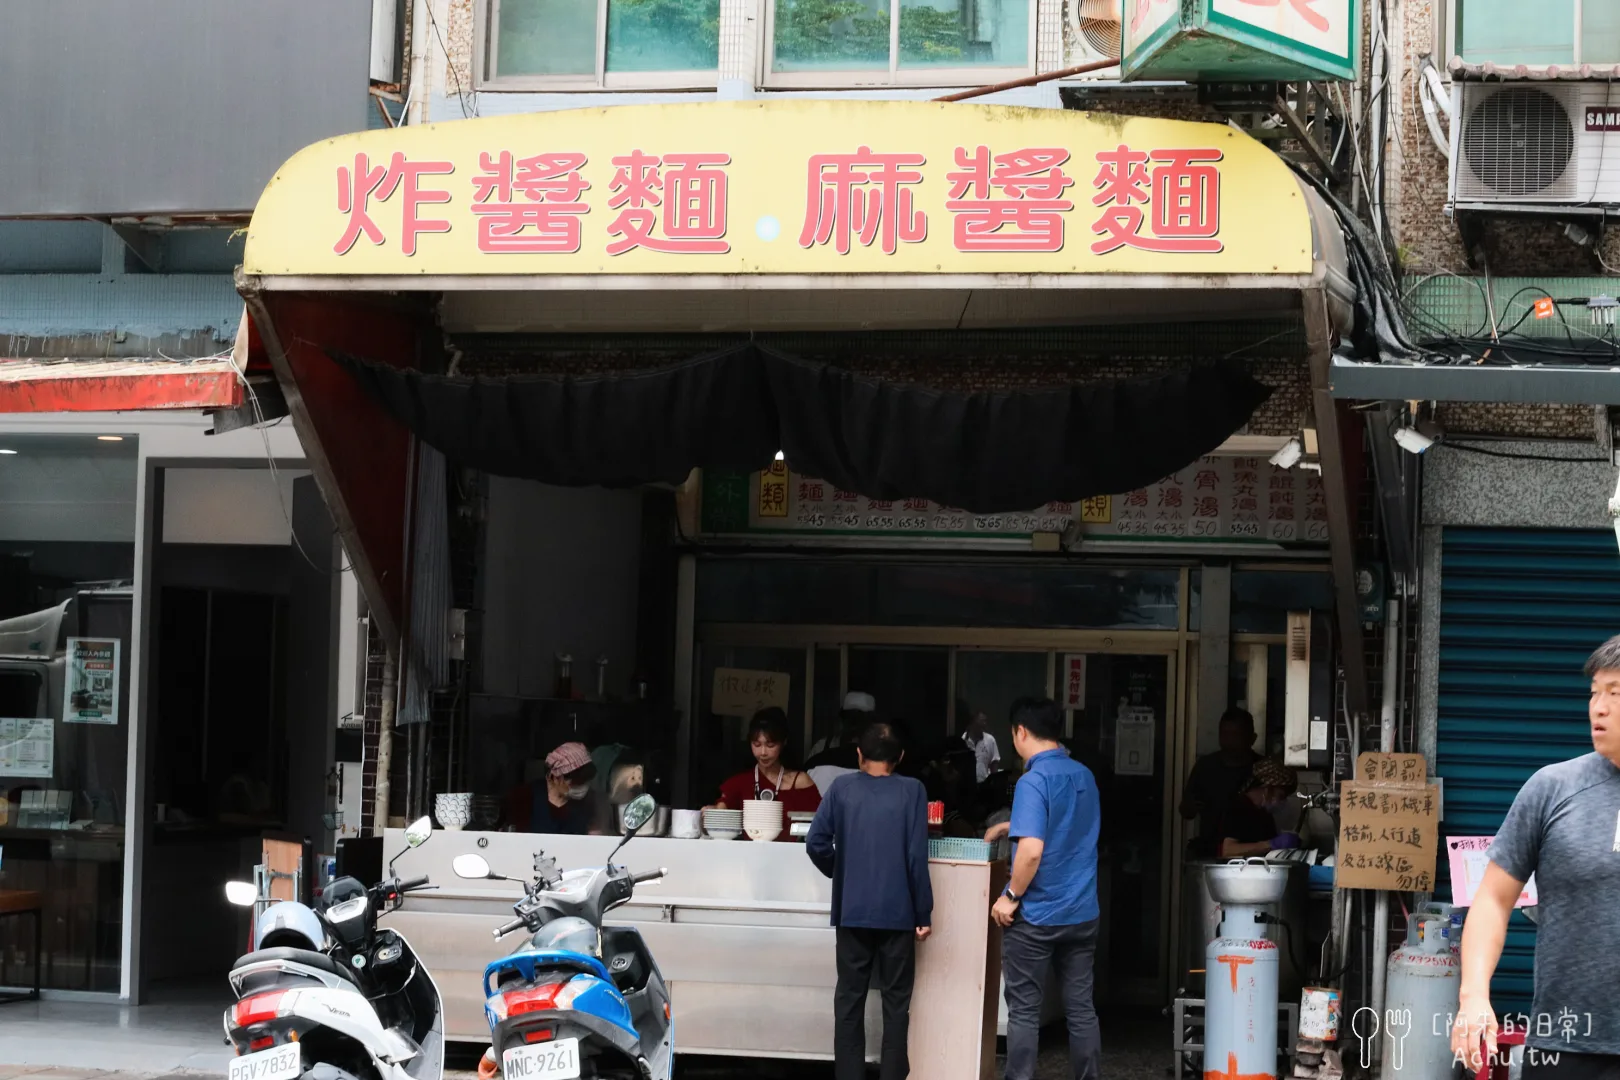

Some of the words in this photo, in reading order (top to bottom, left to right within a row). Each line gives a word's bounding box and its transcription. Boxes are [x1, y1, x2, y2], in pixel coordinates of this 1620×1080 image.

[333, 147, 732, 255] 炸醬麵
[799, 145, 1225, 256] 麻醬麵
[1195, 520, 1217, 536] 50
[1273, 522, 1294, 539] 60
[1365, 758, 1422, 780] 會開罰!
[1396, 871, 1431, 891] 勿停
